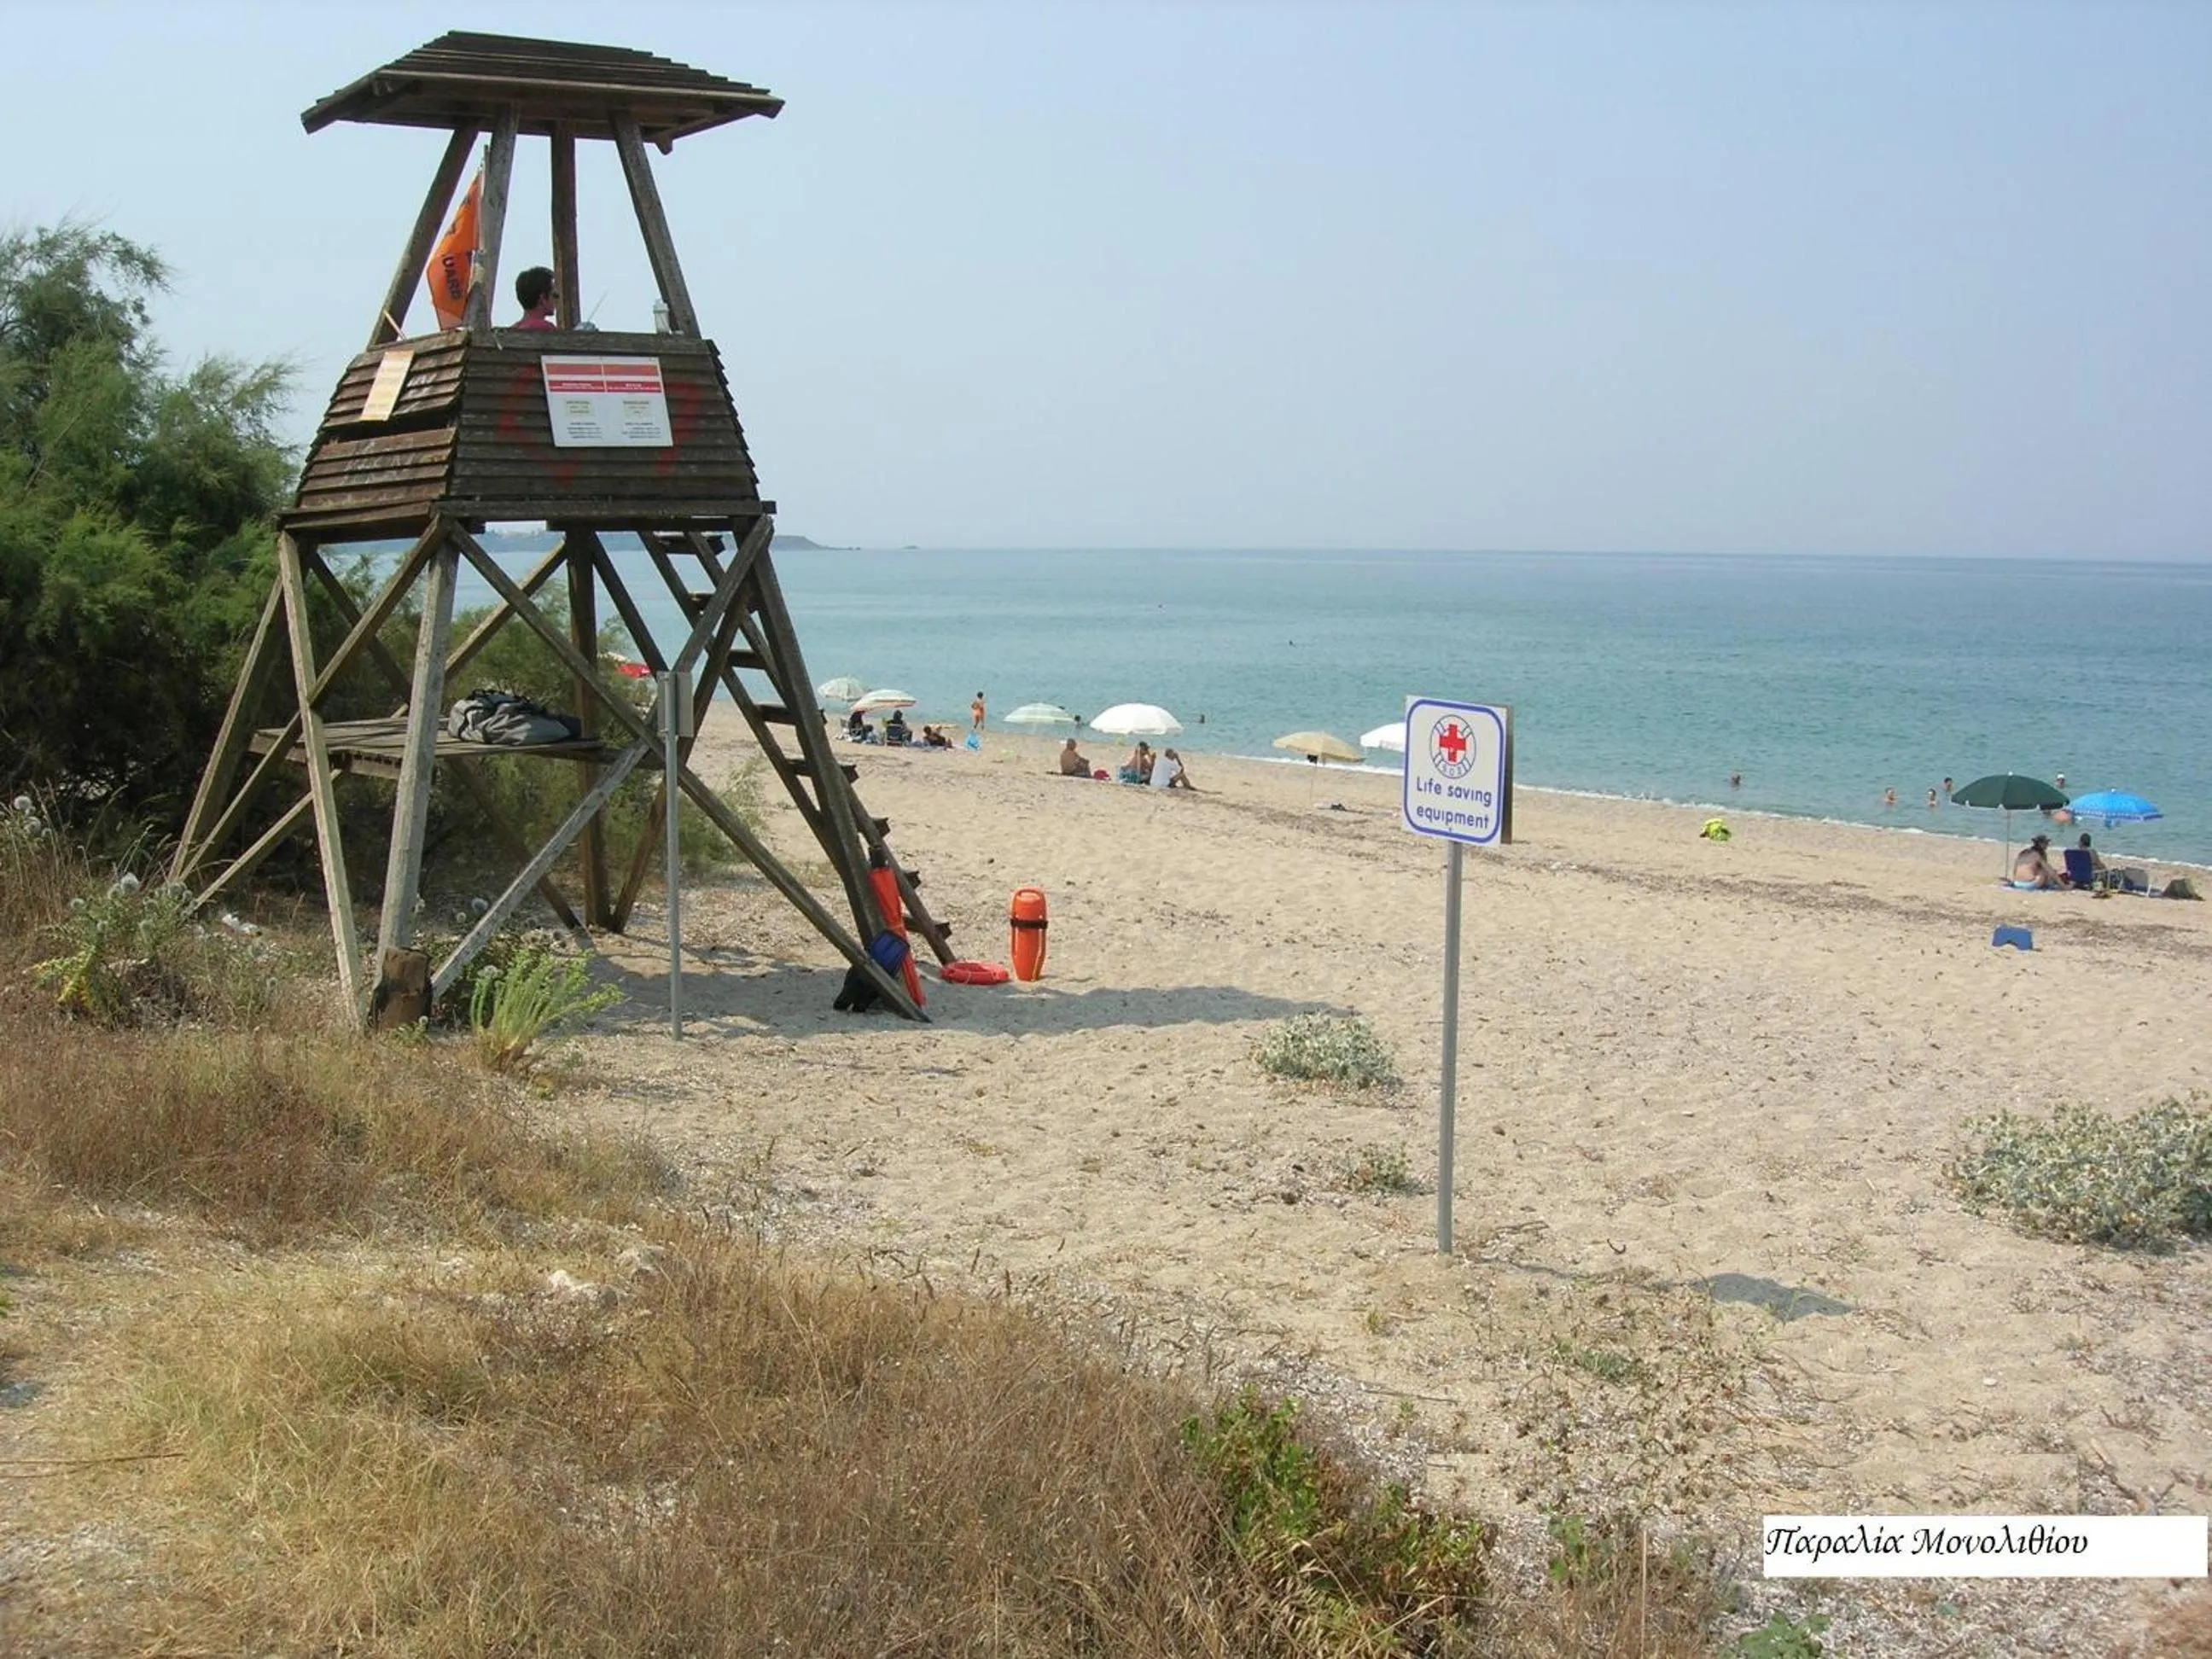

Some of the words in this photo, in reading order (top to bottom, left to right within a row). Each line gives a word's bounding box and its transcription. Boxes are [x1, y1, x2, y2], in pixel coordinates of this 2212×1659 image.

[1417, 776, 1441, 795] Life
[1447, 786, 1491, 807] saving
[1417, 806, 1489, 828] equipment
